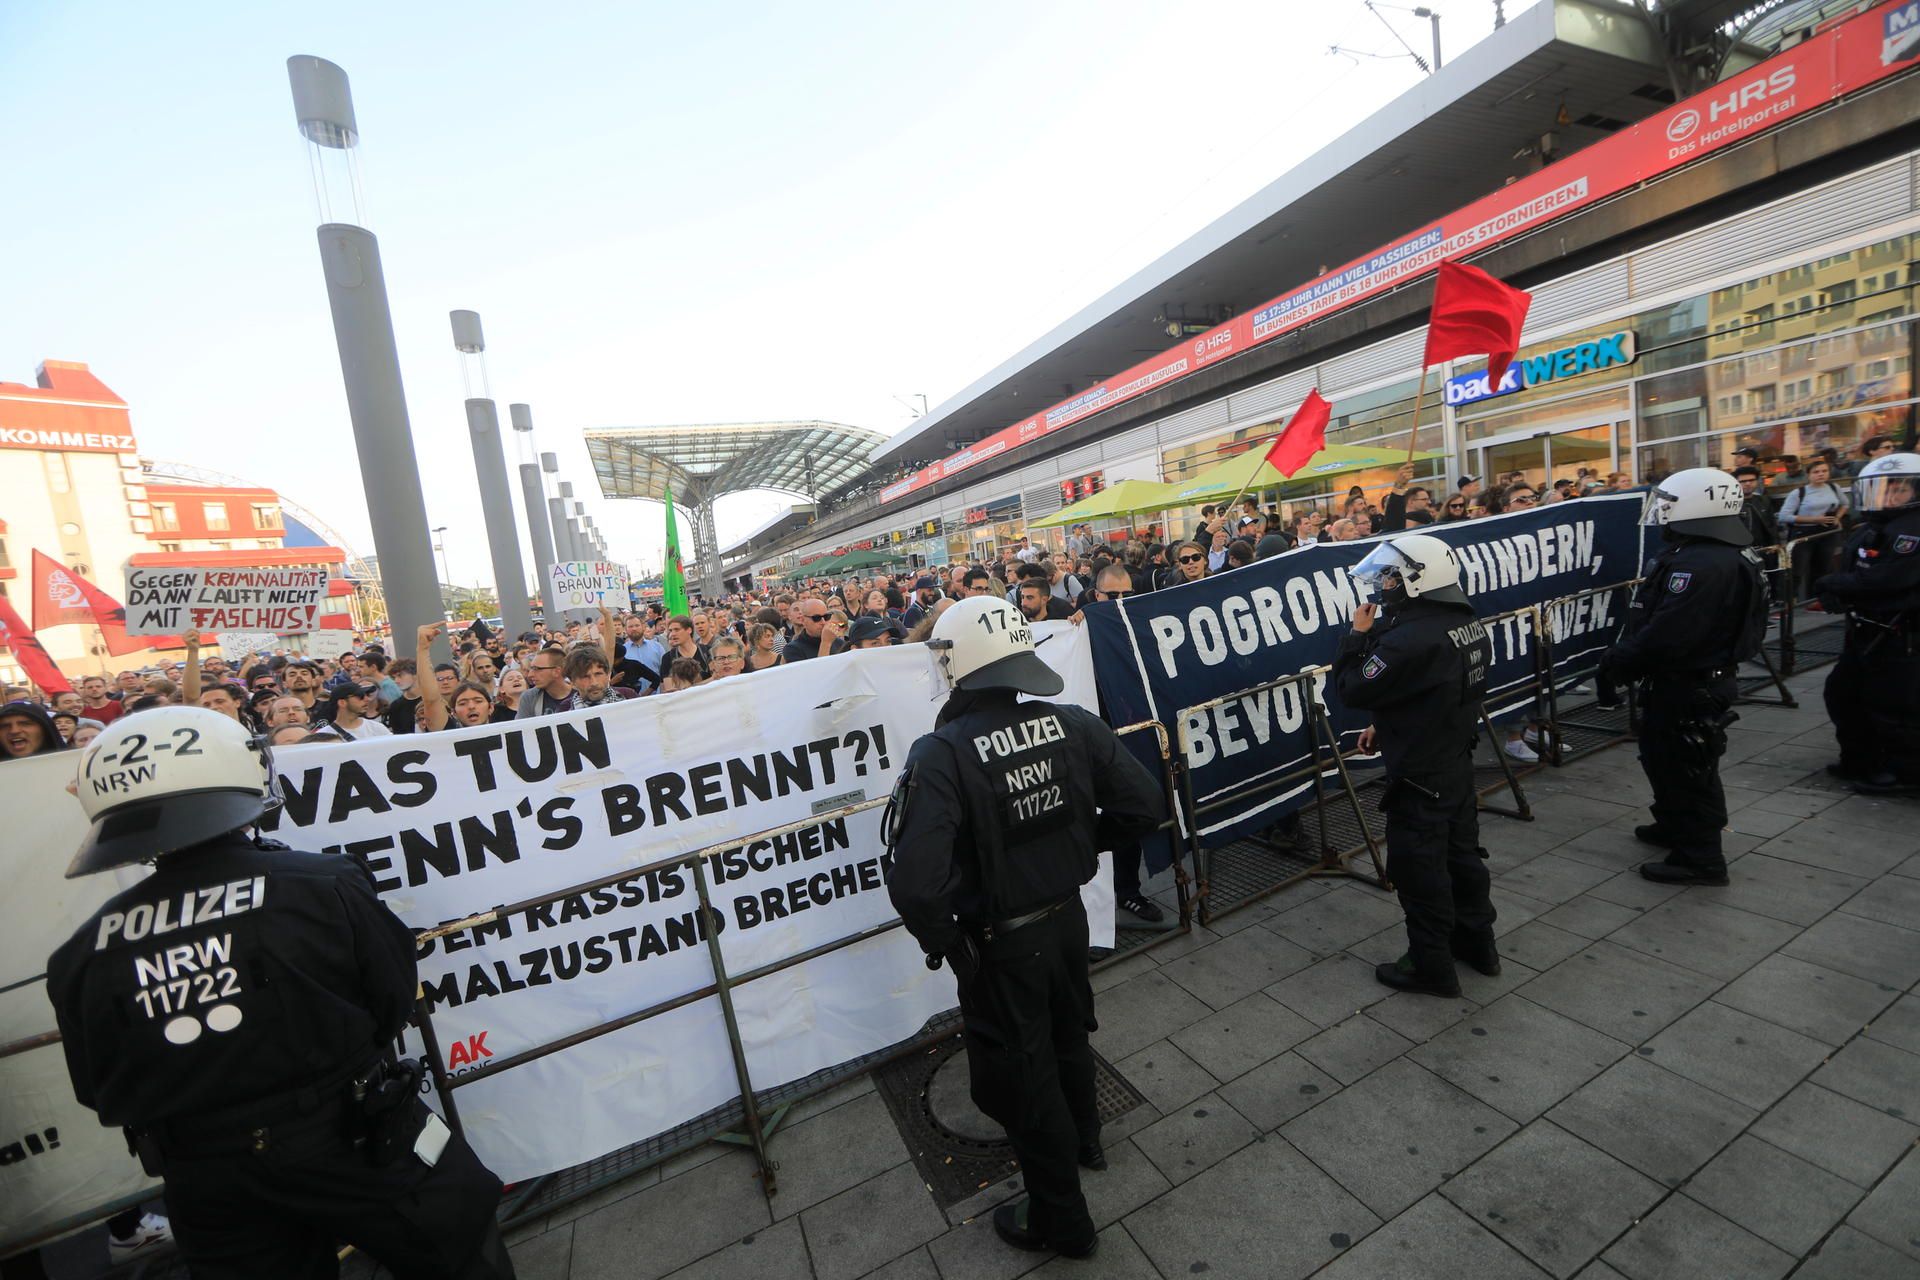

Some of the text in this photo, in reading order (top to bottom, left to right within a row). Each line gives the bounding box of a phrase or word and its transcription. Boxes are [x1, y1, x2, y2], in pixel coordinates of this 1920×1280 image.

[1710, 64, 1796, 122] HRS
[1668, 95, 1796, 160] Das Hotelportal
[1254, 231, 1441, 325] BIS 17:59 UHR KANN VIEL PASSIEREN:
[1255, 184, 1584, 337] IM BUSINESS TARIF BIS 18 UHR KOSTENLOS STORNIEREN.
[1207, 329, 1232, 350] HRS
[1523, 333, 1627, 385] WERK
[0, 428, 136, 449] KOMMERZ
[130, 570, 328, 589] GEGEN KRIMINALITÄT?
[553, 562, 625, 579] ACH HASE
[558, 575, 626, 594] BRAUN IST
[129, 588, 192, 605] DANN
[268, 589, 319, 604] NICHT
[139, 605, 317, 630] MIT FASCHOS!
[571, 591, 605, 606] OUT
[973, 714, 1066, 763] POLIZEI
[1176, 664, 1332, 769] BEVOR
[93, 763, 156, 796] NRW
[258, 717, 611, 832] WAS TUN
[1005, 759, 1053, 793] NRW
[322, 724, 890, 892] ENN'S BRENNT?!
[1013, 785, 1064, 821] 11722
[95, 876, 266, 951] POLIZEI
[134, 933, 232, 987] NRW
[135, 966, 242, 1019] 11722
[449, 1030, 494, 1071] AK
